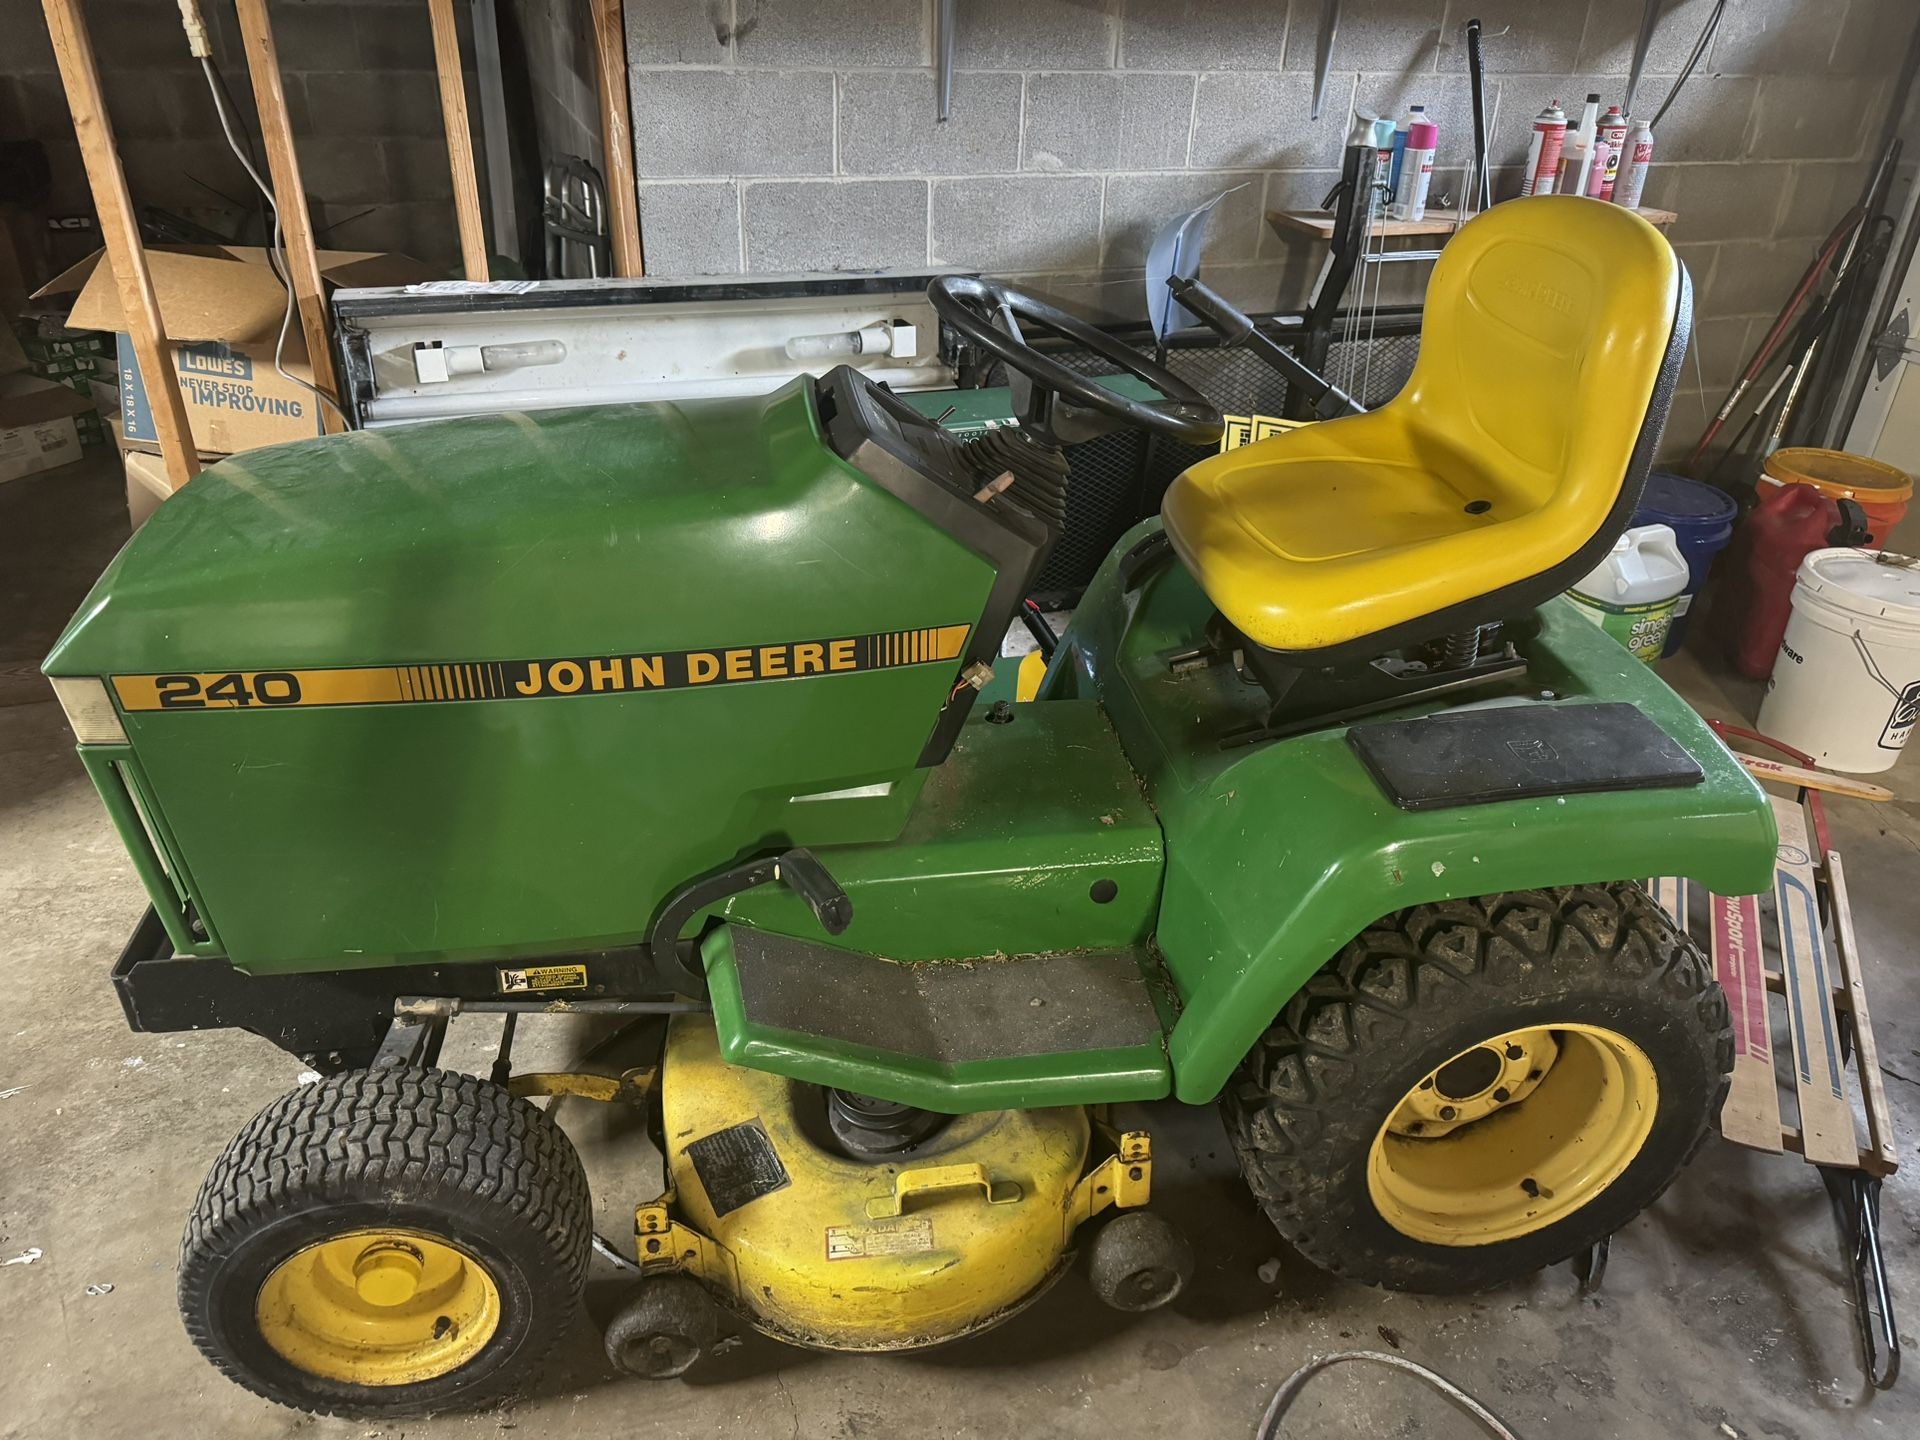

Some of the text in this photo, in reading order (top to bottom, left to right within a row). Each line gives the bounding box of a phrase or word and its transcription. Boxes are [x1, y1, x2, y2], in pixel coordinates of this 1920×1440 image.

[185, 351, 246, 376] LOWE'S
[123, 368, 133, 381] 18
[179, 377, 254, 396] NEVER STOP
[125, 394, 135, 407] 18
[191, 387, 304, 419] IMPROVING
[127, 420, 137, 433] 16
[515, 640, 857, 695] JOHN DEERE
[155, 672, 302, 708] 240
[540, 966, 578, 975] WARNING
